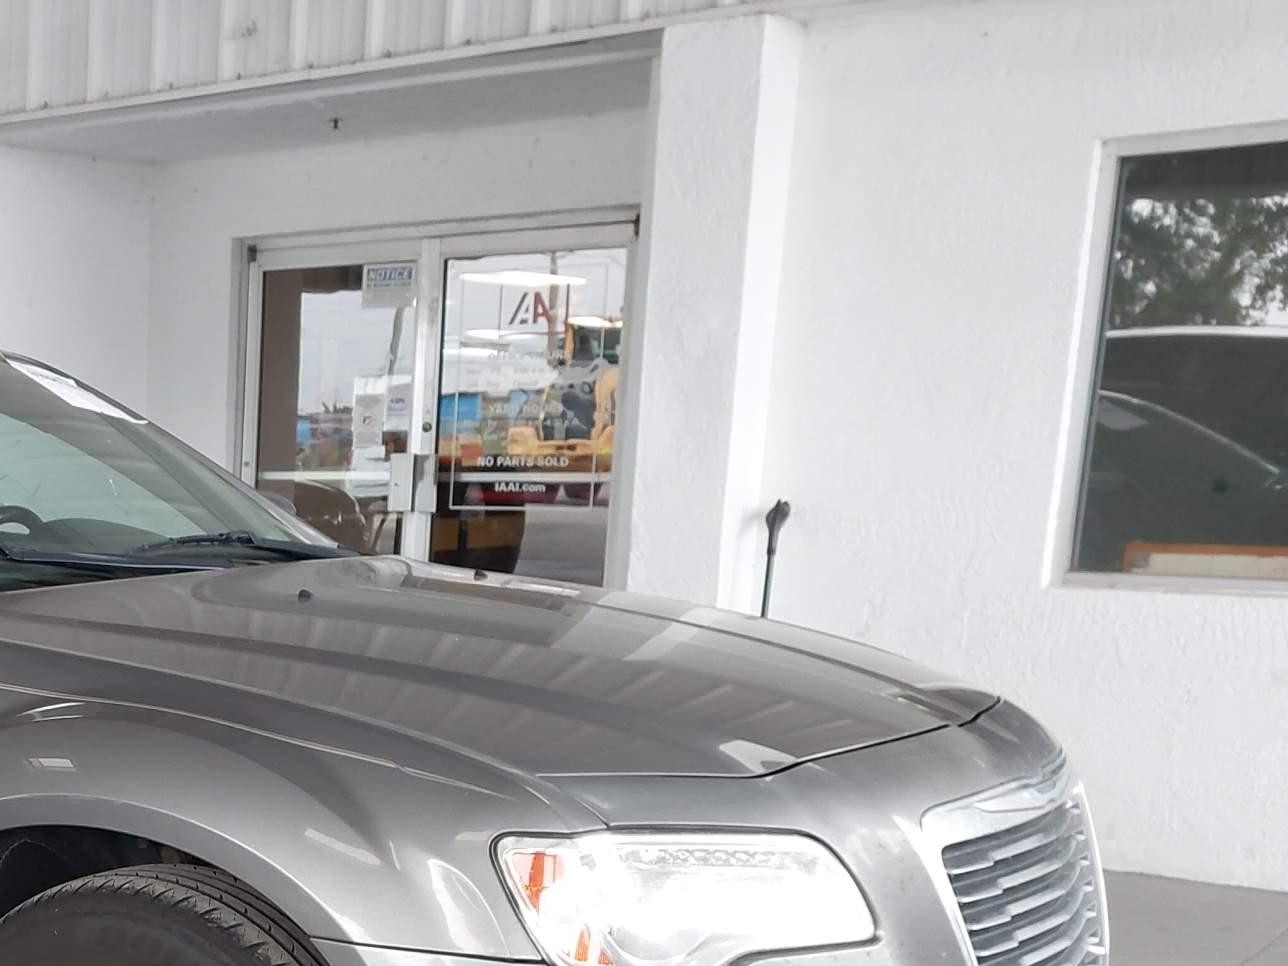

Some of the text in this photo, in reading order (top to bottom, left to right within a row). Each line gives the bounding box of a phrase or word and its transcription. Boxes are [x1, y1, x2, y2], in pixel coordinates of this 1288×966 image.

[368, 267, 412, 280] NOTICE
[477, 456, 569, 467] NO PARTS SOLD
[495, 482, 546, 492] IAAI.com
